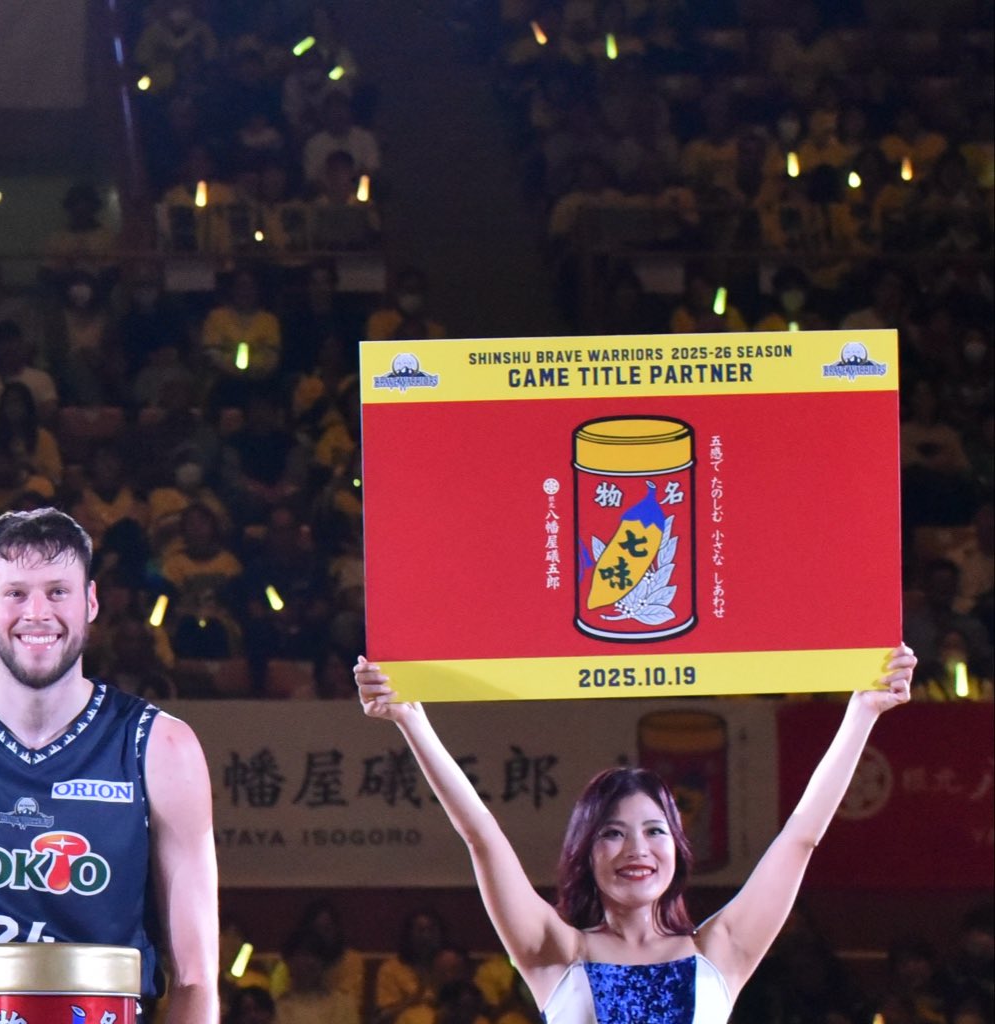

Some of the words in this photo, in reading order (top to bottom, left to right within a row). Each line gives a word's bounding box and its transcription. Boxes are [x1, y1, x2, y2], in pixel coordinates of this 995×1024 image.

[469, 351, 531, 365] SHINSHU
[536, 350, 582, 364] BRAVE
[588, 347, 664, 363] WARRIORS
[671, 346, 732, 360] 2025-26
[737, 345, 793, 359] SEASON
[508, 367, 570, 388] GAME
[577, 365, 643, 386] TITLE
[649, 363, 753, 386] PARTNER
[709, 435, 724, 472] 五感で
[710, 477, 724, 522] たのしむ
[711, 530, 725, 566] 小さな
[712, 573, 725, 618] しあわせ
[578, 666, 696, 688] 2025.10.19
[53, 780, 133, 801] ORION
